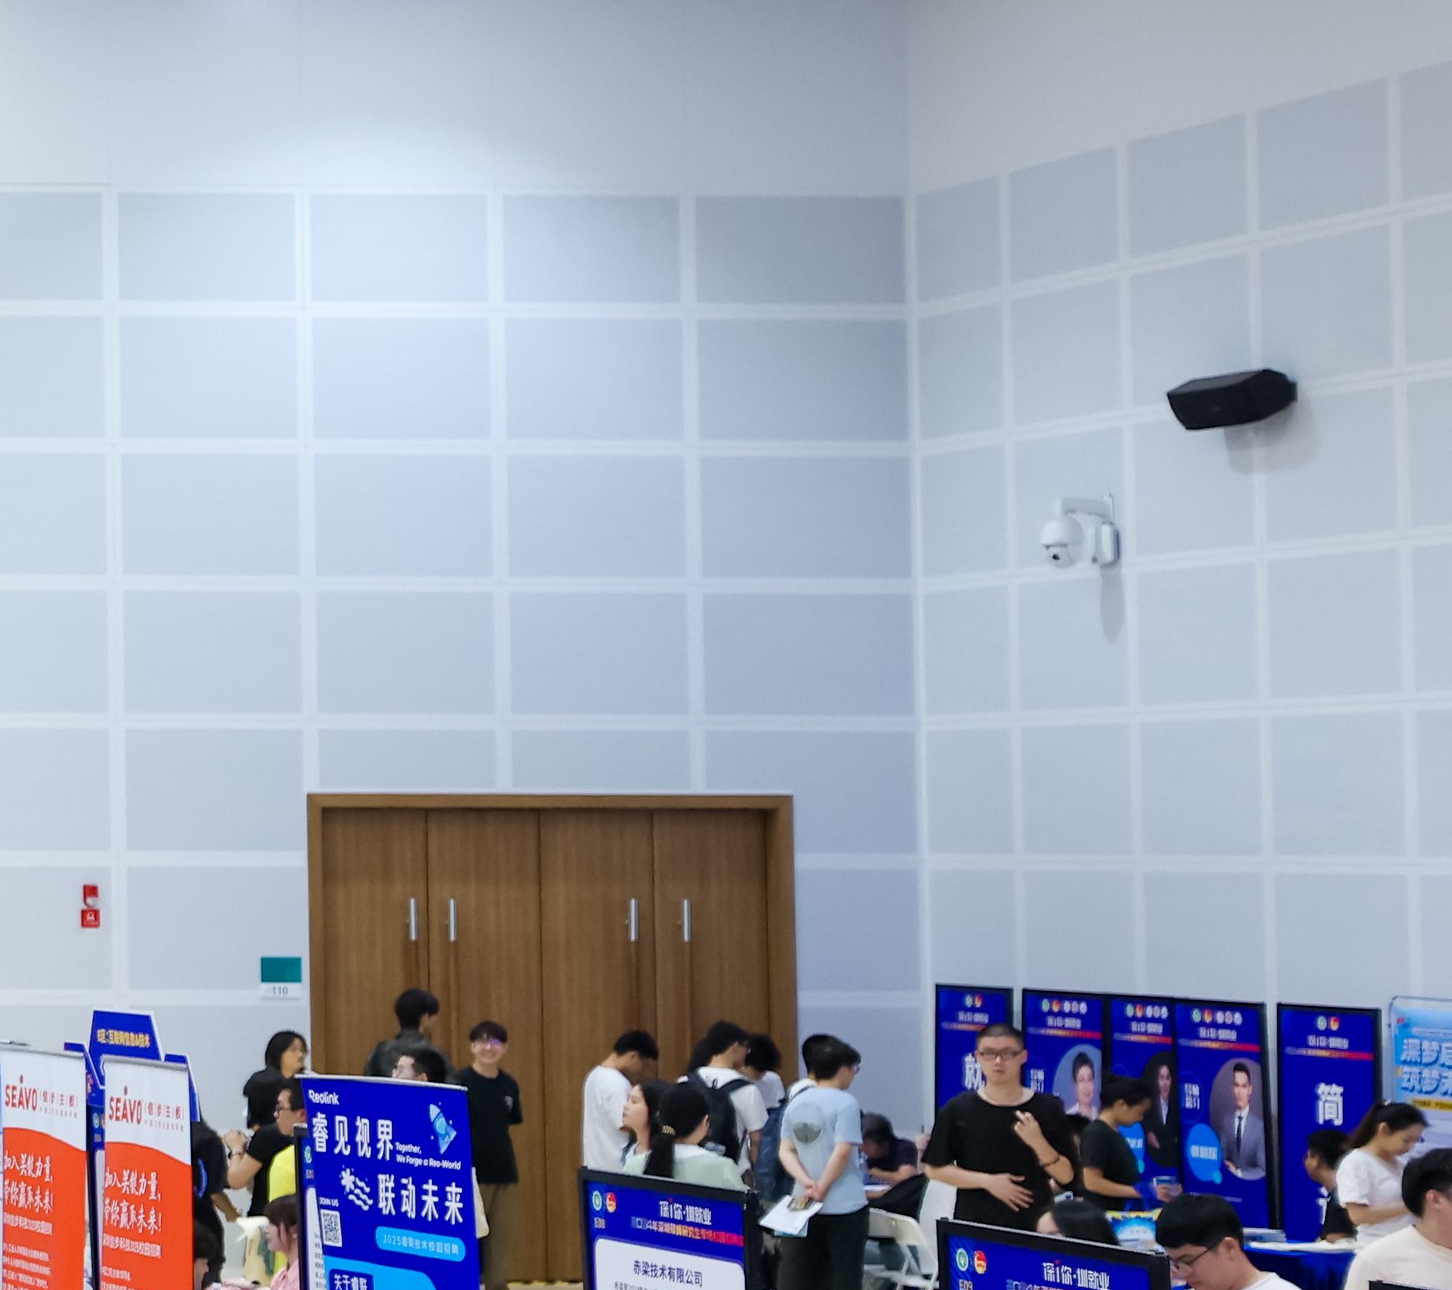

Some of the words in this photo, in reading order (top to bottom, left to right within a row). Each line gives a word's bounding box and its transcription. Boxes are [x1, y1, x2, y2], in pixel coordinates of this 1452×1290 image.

[5, 1076, 38, 1112] SEAVO
[109, 1086, 143, 1125] SEAVO
[308, 1089, 340, 1105] Reolink
[312, 1112, 394, 1161] 睿见视界
[377, 1174, 464, 1225] 联动未来
[633, 1260, 703, 1288] 赤梁技术有限公司
